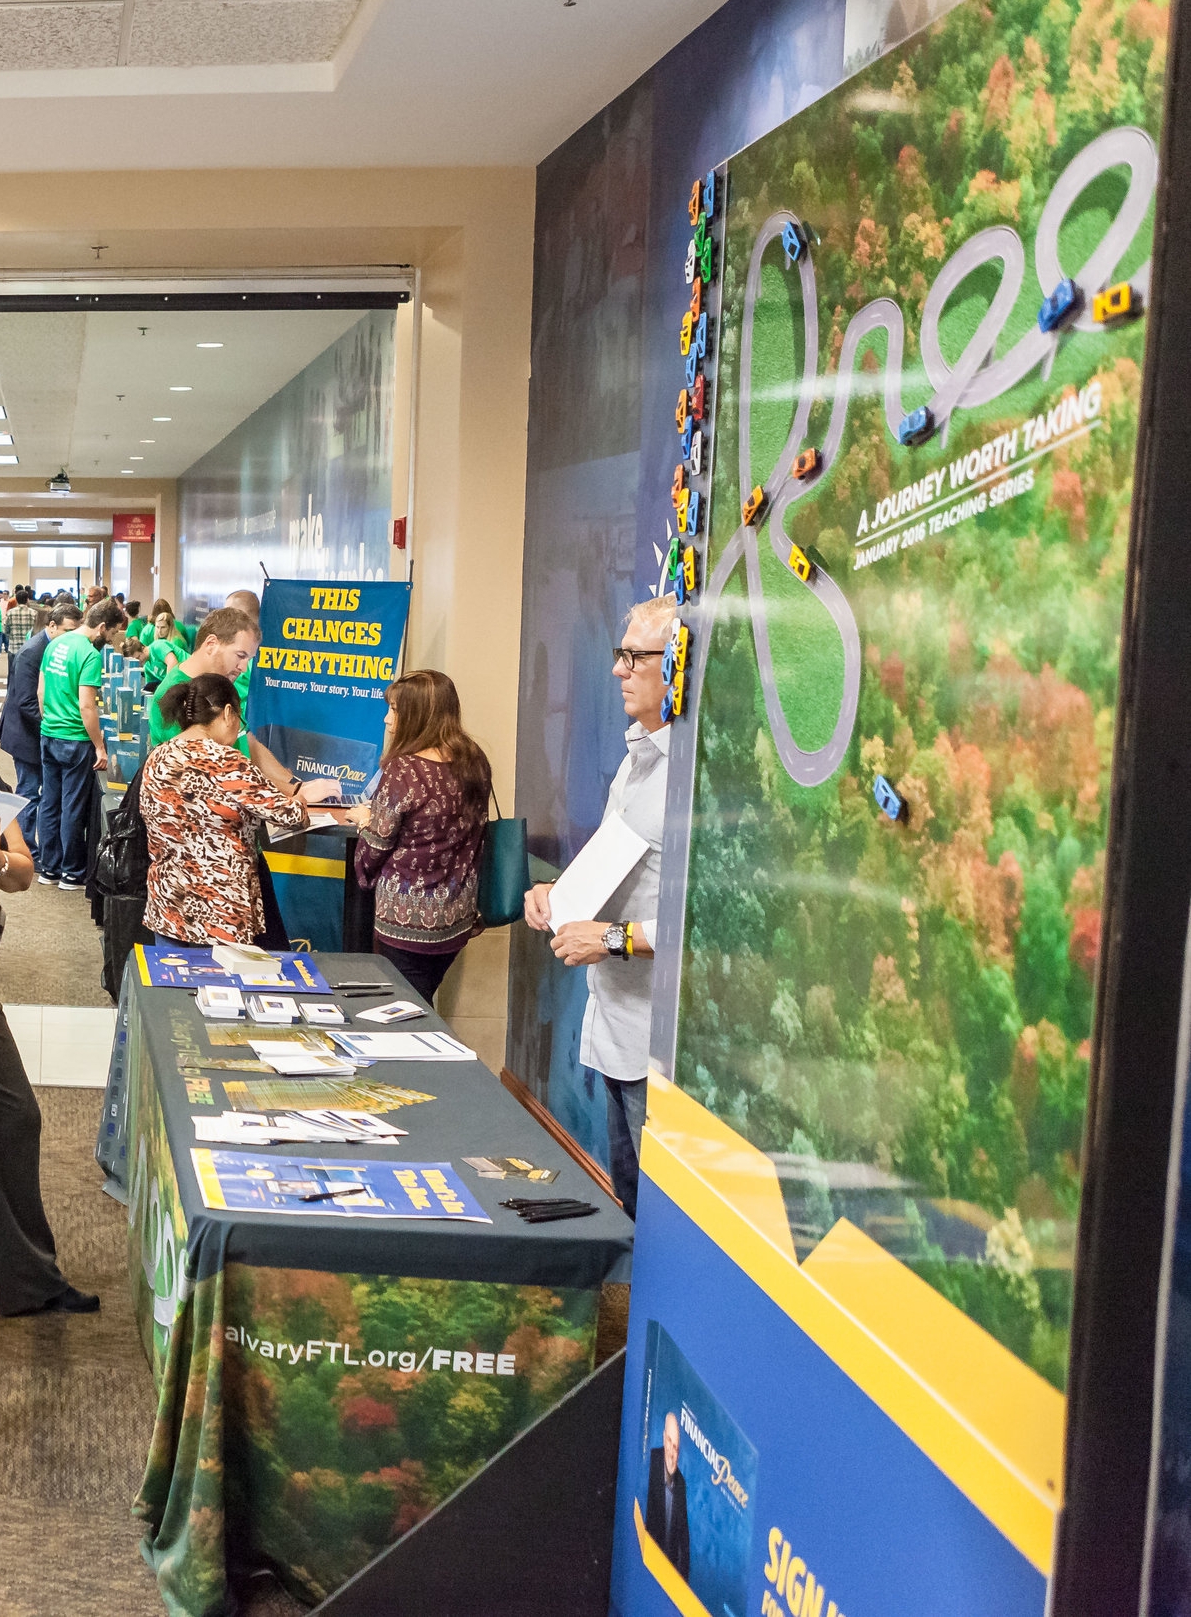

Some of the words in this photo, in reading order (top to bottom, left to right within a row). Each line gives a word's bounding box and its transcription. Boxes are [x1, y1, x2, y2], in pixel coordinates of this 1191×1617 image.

[856, 510, 869, 537] A
[871, 467, 946, 529] JOURNEY
[949, 429, 1018, 489] WORTH
[1022, 381, 1102, 451] TAKING
[853, 534, 900, 571] JANUARY
[901, 522, 926, 549] 2016
[928, 492, 987, 536] TEACHING
[989, 469, 1035, 507] SERIES
[310, 587, 361, 612] THIS
[282, 617, 382, 646] CHANGES
[257, 647, 396, 681] EVERYTHING.
[265, 676, 280, 688] Your
[281, 679, 308, 693] money.
[310, 681, 328, 694] Your
[329, 684, 350, 697] story.
[351, 686, 370, 698] Your
[371, 688, 385, 700] life.
[296, 759, 339, 777] FINANCIAL
[336, 764, 367, 783] Peace
[225, 1325, 516, 1376] alvaryFTL.org/FREE
[680, 1407, 721, 1475] FINANCIAL
[711, 1455, 749, 1509] Peace
[764, 1526, 825, 1617] SIGN
